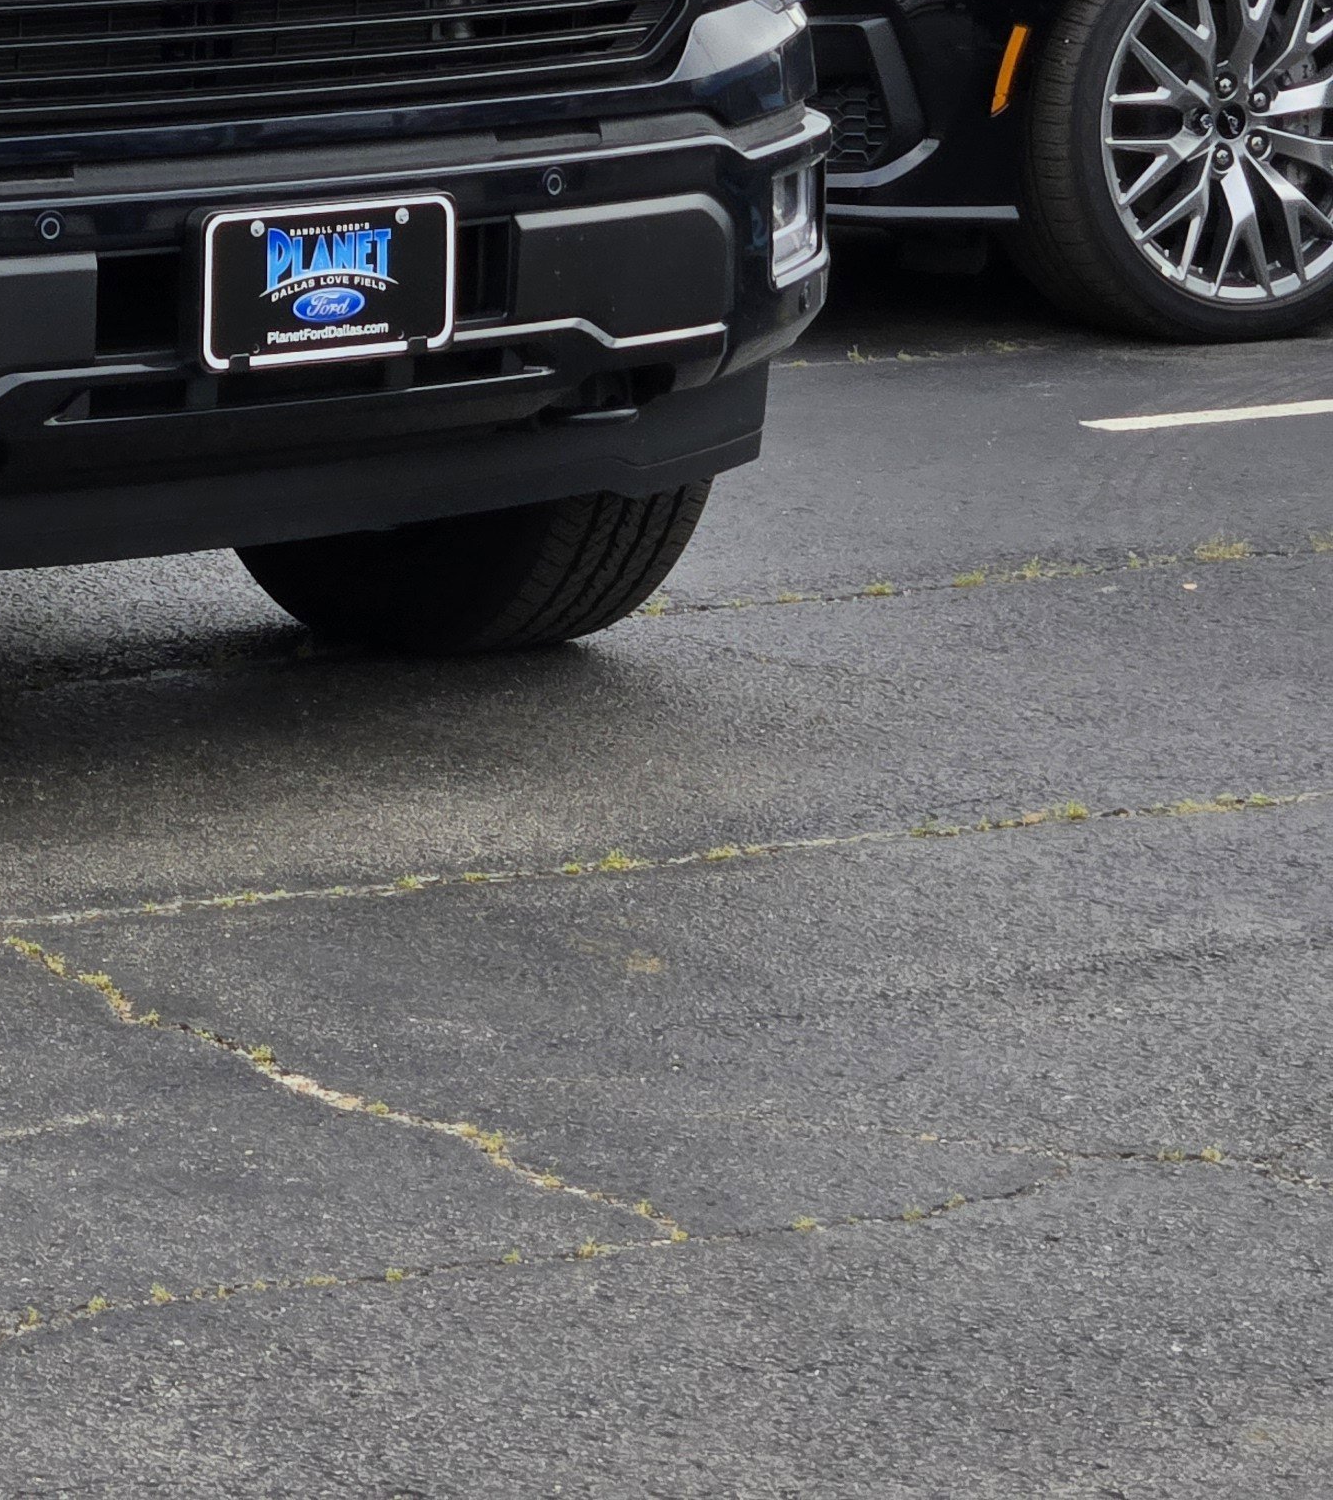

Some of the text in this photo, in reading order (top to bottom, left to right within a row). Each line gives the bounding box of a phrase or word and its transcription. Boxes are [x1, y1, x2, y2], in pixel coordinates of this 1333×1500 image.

[290, 225, 332, 237] RANDALL
[266, 226, 392, 293] PLANET
[270, 275, 387, 303] DALLAS LOVE FIELD
[306, 292, 351, 318] Ford
[266, 322, 389, 346] PlanetFordDallas.com
